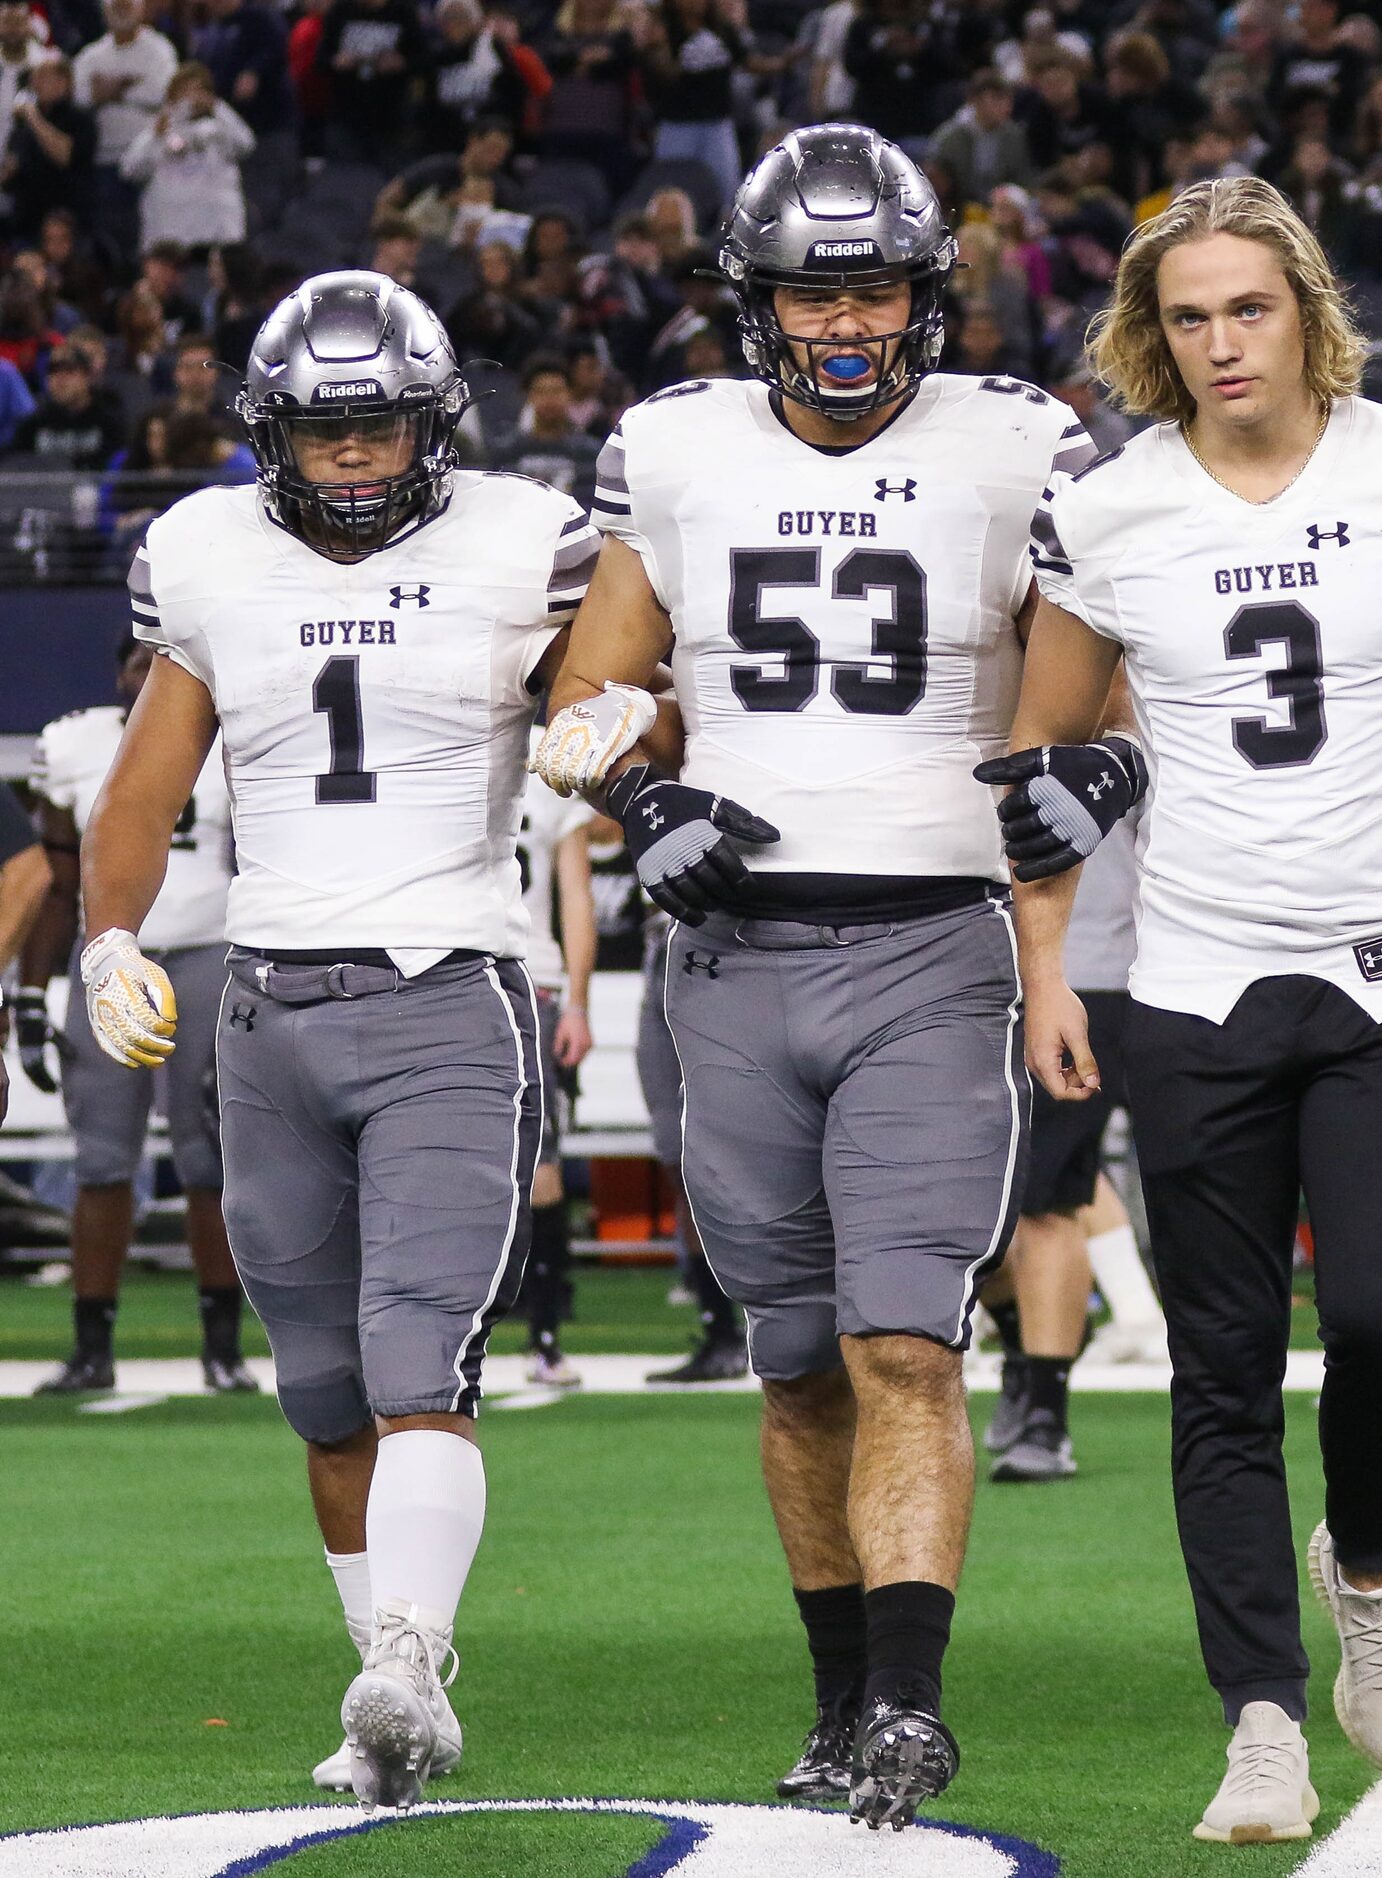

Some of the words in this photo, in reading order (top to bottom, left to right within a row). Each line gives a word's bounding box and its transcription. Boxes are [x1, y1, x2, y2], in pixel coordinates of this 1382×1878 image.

[814, 241, 874, 257] Riddell
[318, 383, 377, 399] Riddell
[778, 511, 877, 537] GUYER
[1215, 561, 1319, 594] GUYER
[300, 620, 396, 647] GUYER
[728, 546, 929, 715] 53
[1223, 599, 1329, 770] 3
[312, 654, 378, 805] 1
